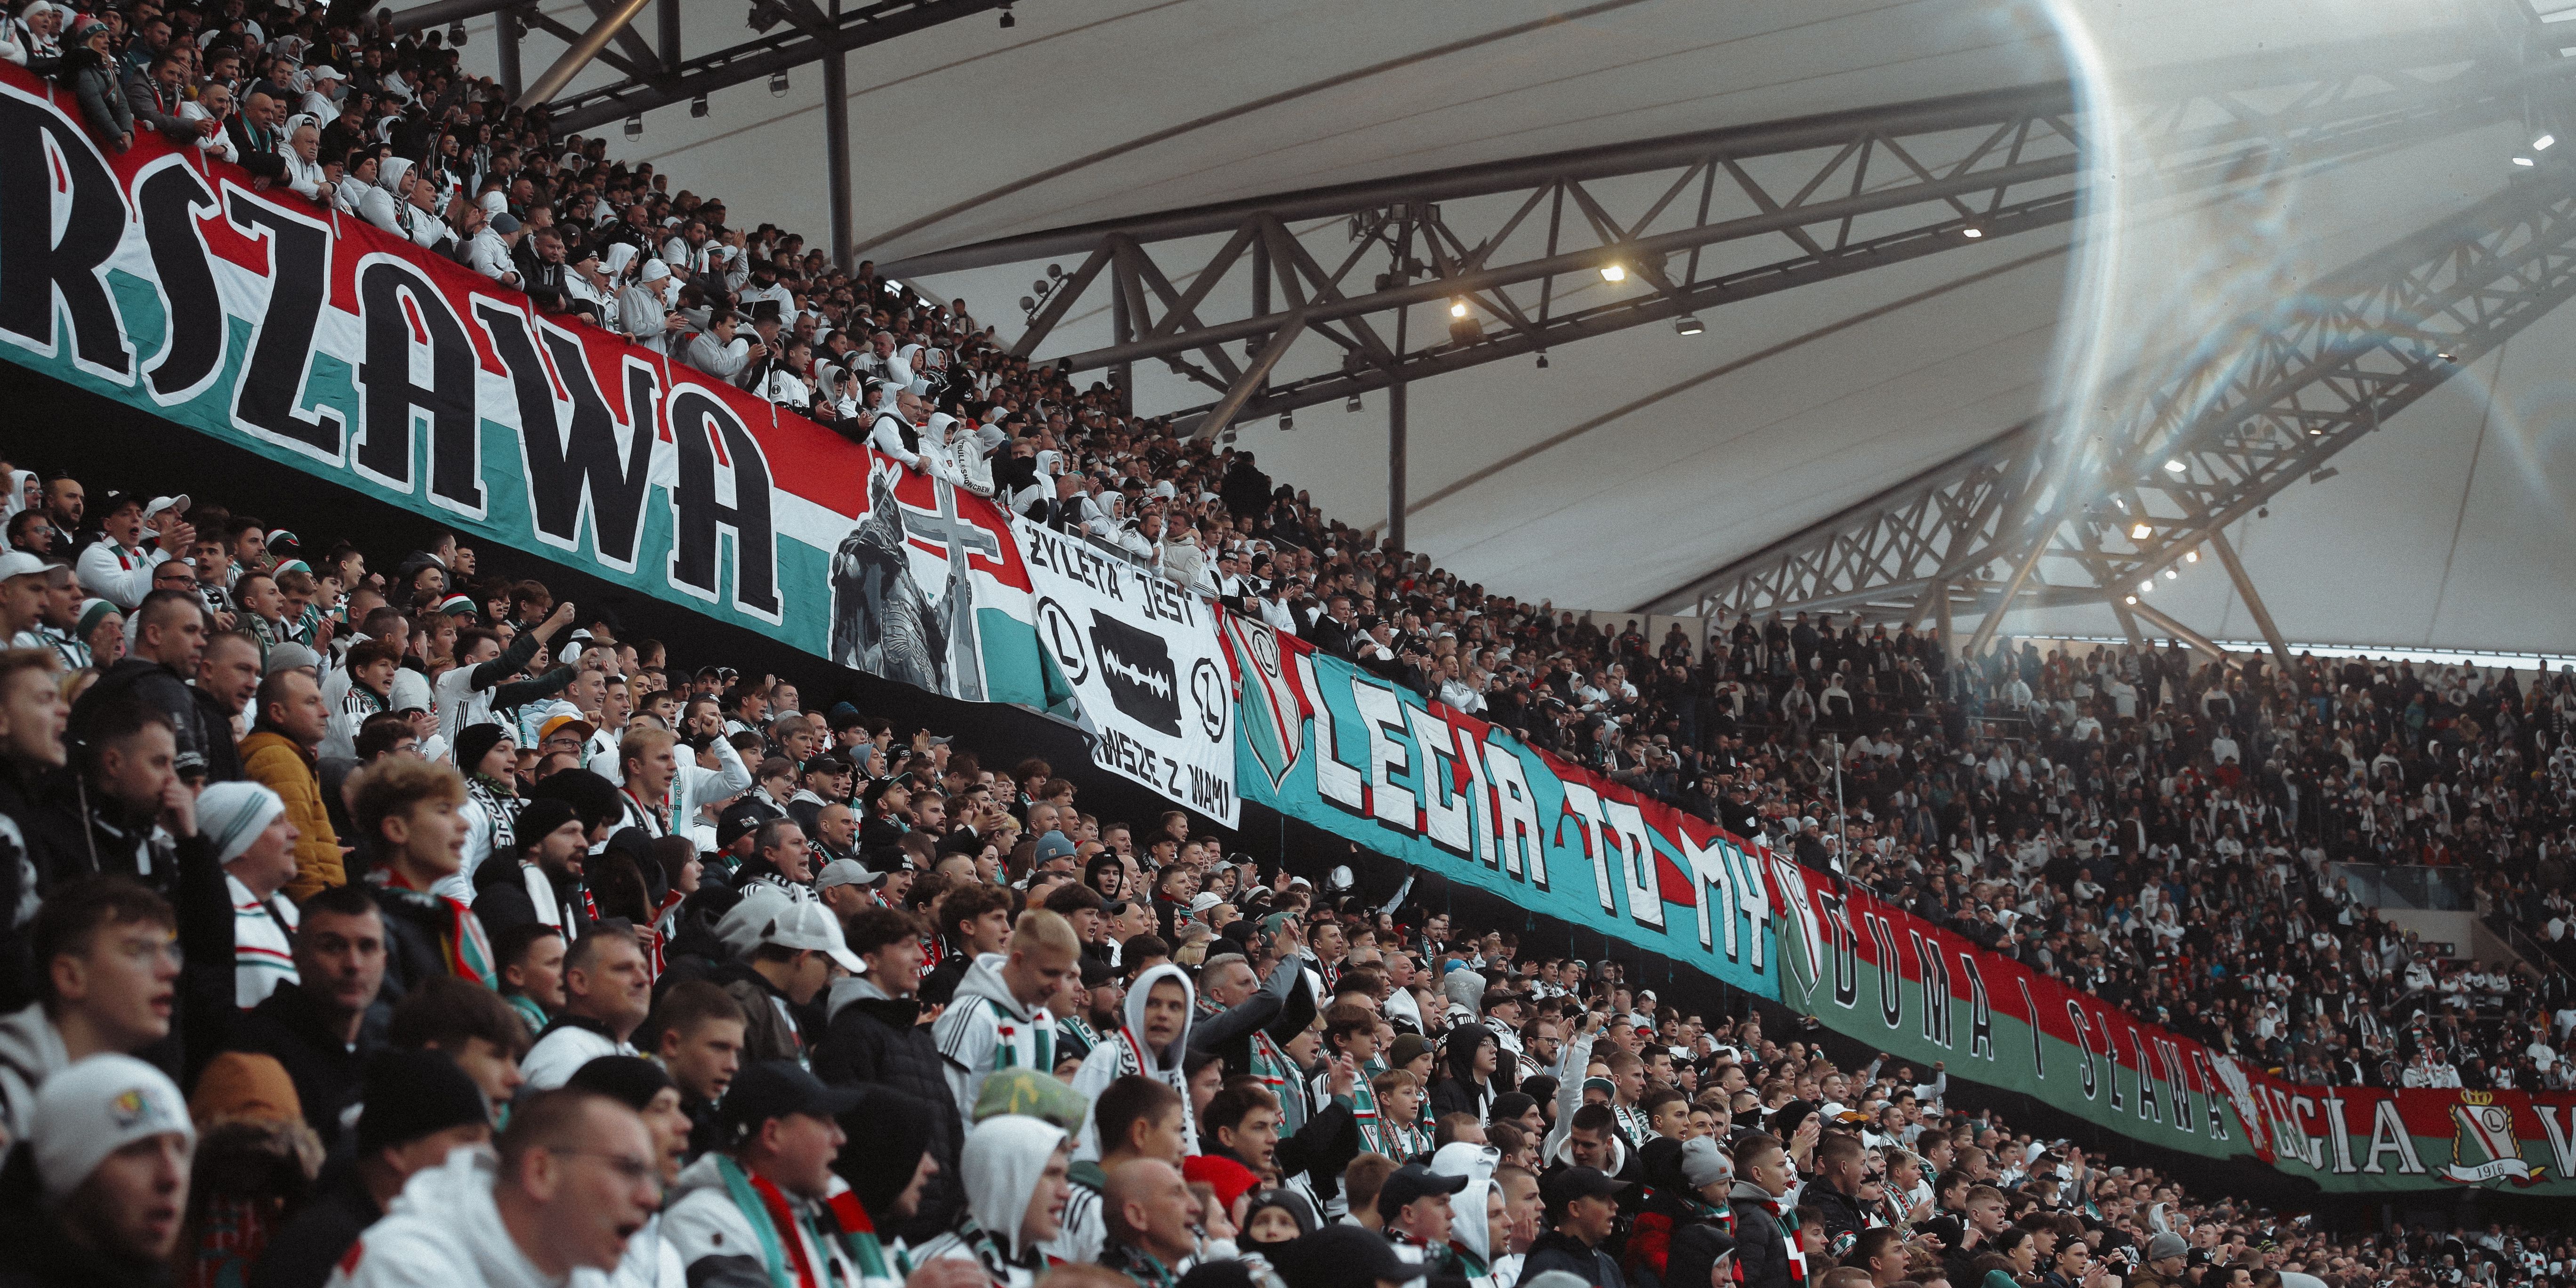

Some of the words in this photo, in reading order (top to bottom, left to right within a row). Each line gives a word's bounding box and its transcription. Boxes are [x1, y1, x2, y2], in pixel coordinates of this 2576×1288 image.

[0, 82, 783, 626] RSZAWA
[961, 469, 990, 492] SNOWCREW
[1135, 572, 1195, 628] JEST
[1163, 757, 1183, 799] Z
[1562, 780, 1667, 934] TO
[1678, 825, 1771, 974] MY
[1817, 888, 1994, 1062] DUMA
[2017, 976, 2044, 1080] I
[2066, 998, 2230, 1141] SŁAWA
[2255, 1083, 2426, 1174] LEGIA
[2476, 1163, 2505, 1179] 1916
